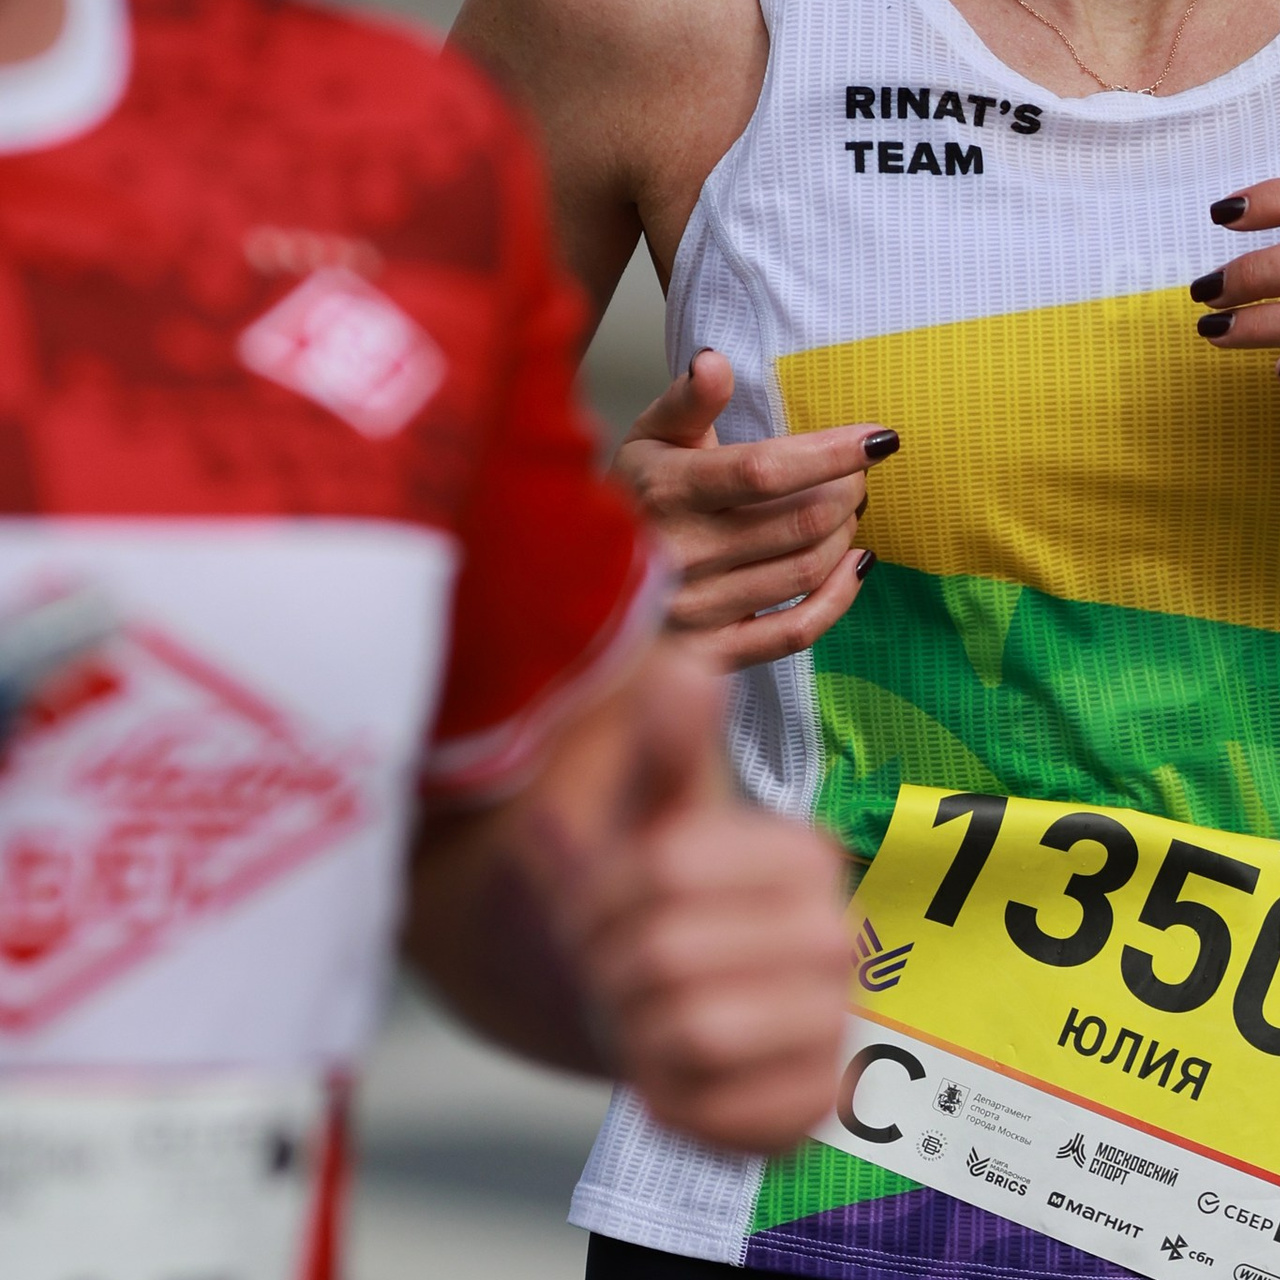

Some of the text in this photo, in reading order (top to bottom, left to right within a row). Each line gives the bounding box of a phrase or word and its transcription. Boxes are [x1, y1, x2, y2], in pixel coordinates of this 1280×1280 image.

[845, 141, 984, 176] TEAM
[1057, 1007, 1212, 1101] ЮЛИЯ
[970, 1104, 1000, 1122] спорта
[973, 1093, 1032, 1122] Департамент
[966, 1114, 1033, 1146] города Москвы
[1088, 1157, 1131, 1186] СПОРТ
[1094, 1141, 1180, 1187] МОСКОВСКИЙ
[984, 1170, 1028, 1196] BRICS
[1223, 1204, 1274, 1232] СБЕР
